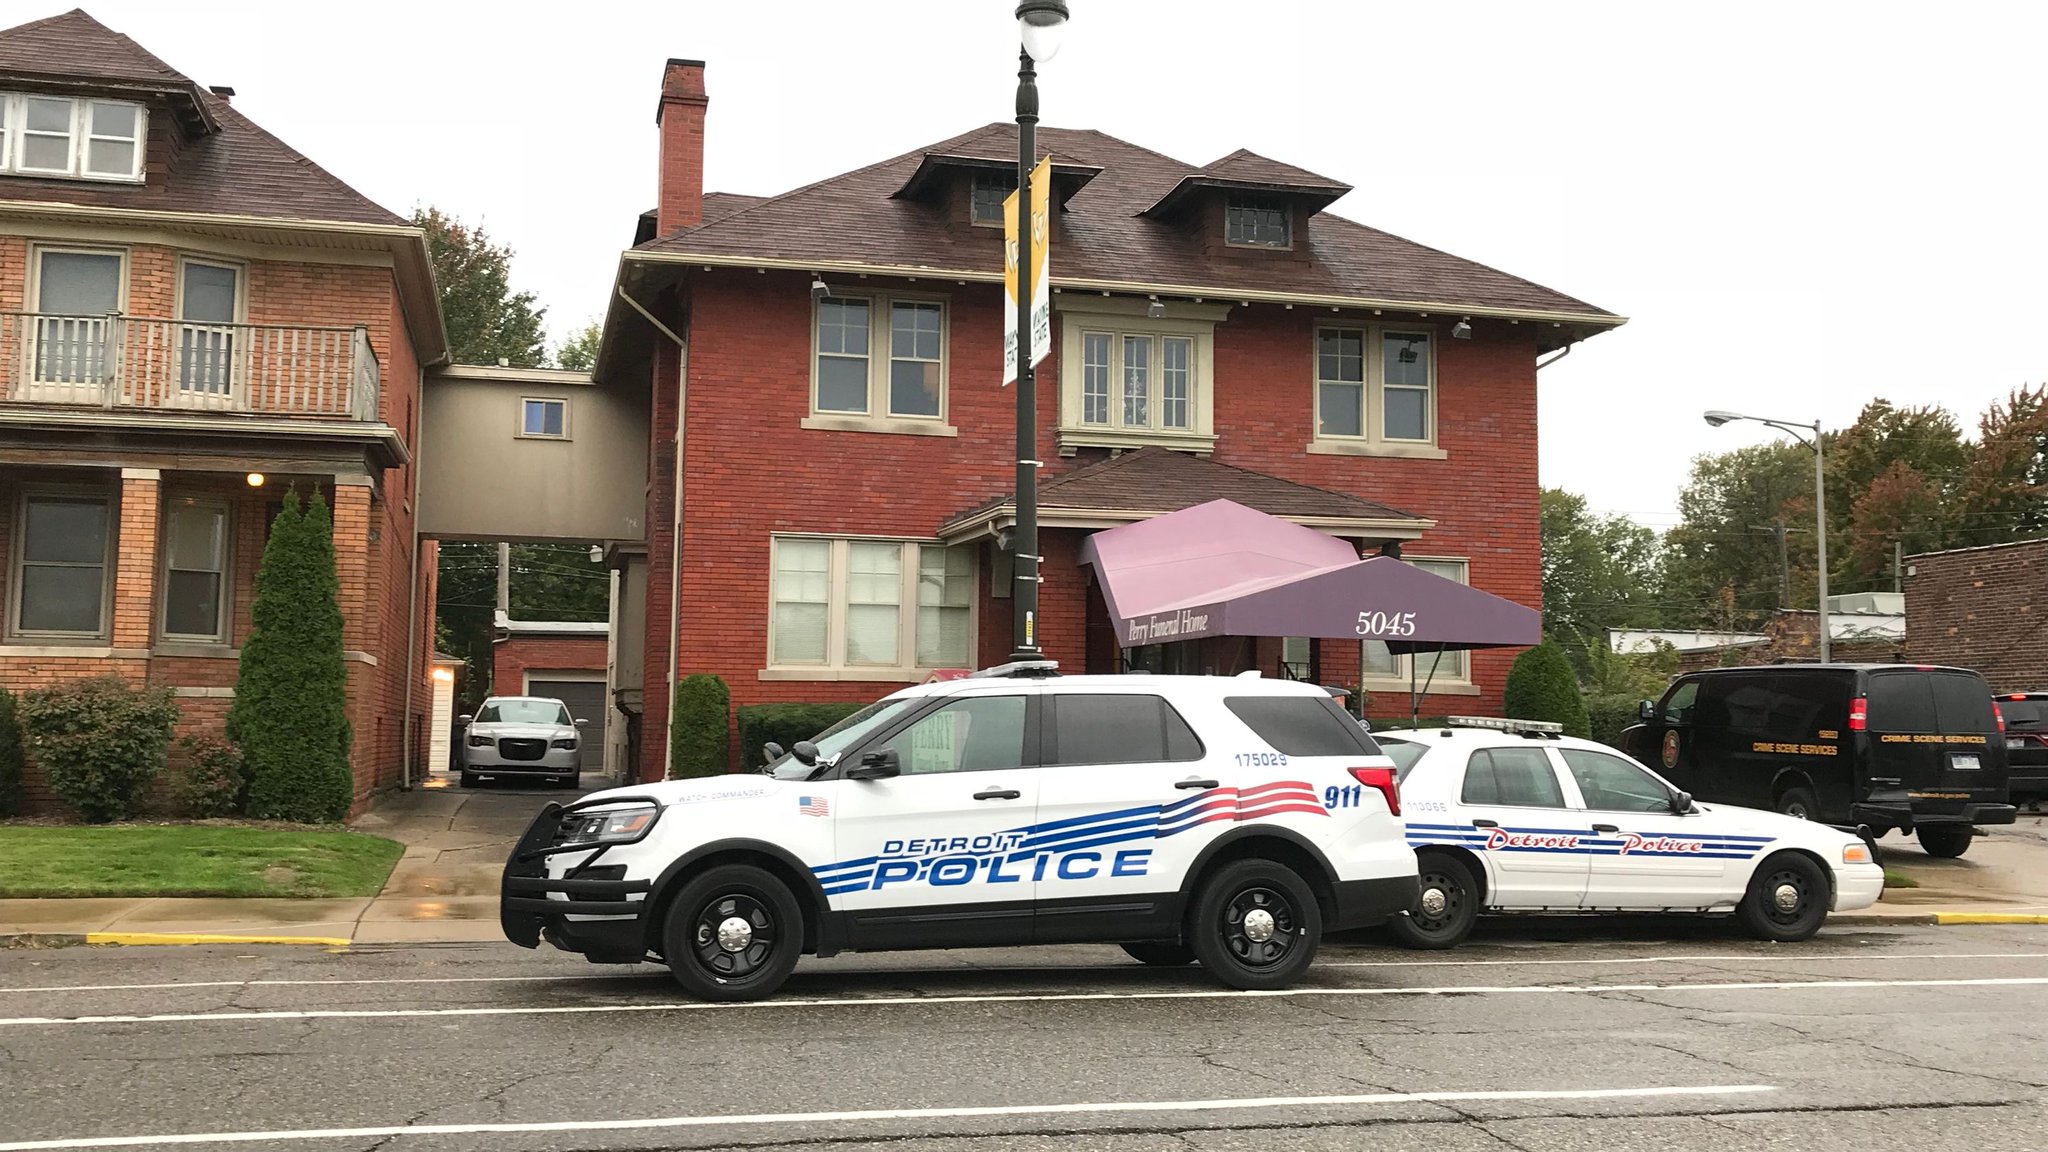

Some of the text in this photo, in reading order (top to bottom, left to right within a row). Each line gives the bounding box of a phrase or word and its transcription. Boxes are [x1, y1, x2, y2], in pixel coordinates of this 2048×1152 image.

[1034, 321, 1048, 348] STATE
[1128, 609, 1209, 645] Perry Funeral Home
[1355, 610, 1417, 637] 5045
[1753, 742, 1838, 756] CRIME SCENE SERVICES
[1881, 735, 1987, 744] CRIME SCENE SERVICES
[1235, 752, 1288, 767] 175029
[1324, 785, 1361, 809] 911
[883, 834, 1025, 854] DETROIT
[1480, 828, 1703, 854] Detroit Police
[871, 849, 1153, 890] POLICE
